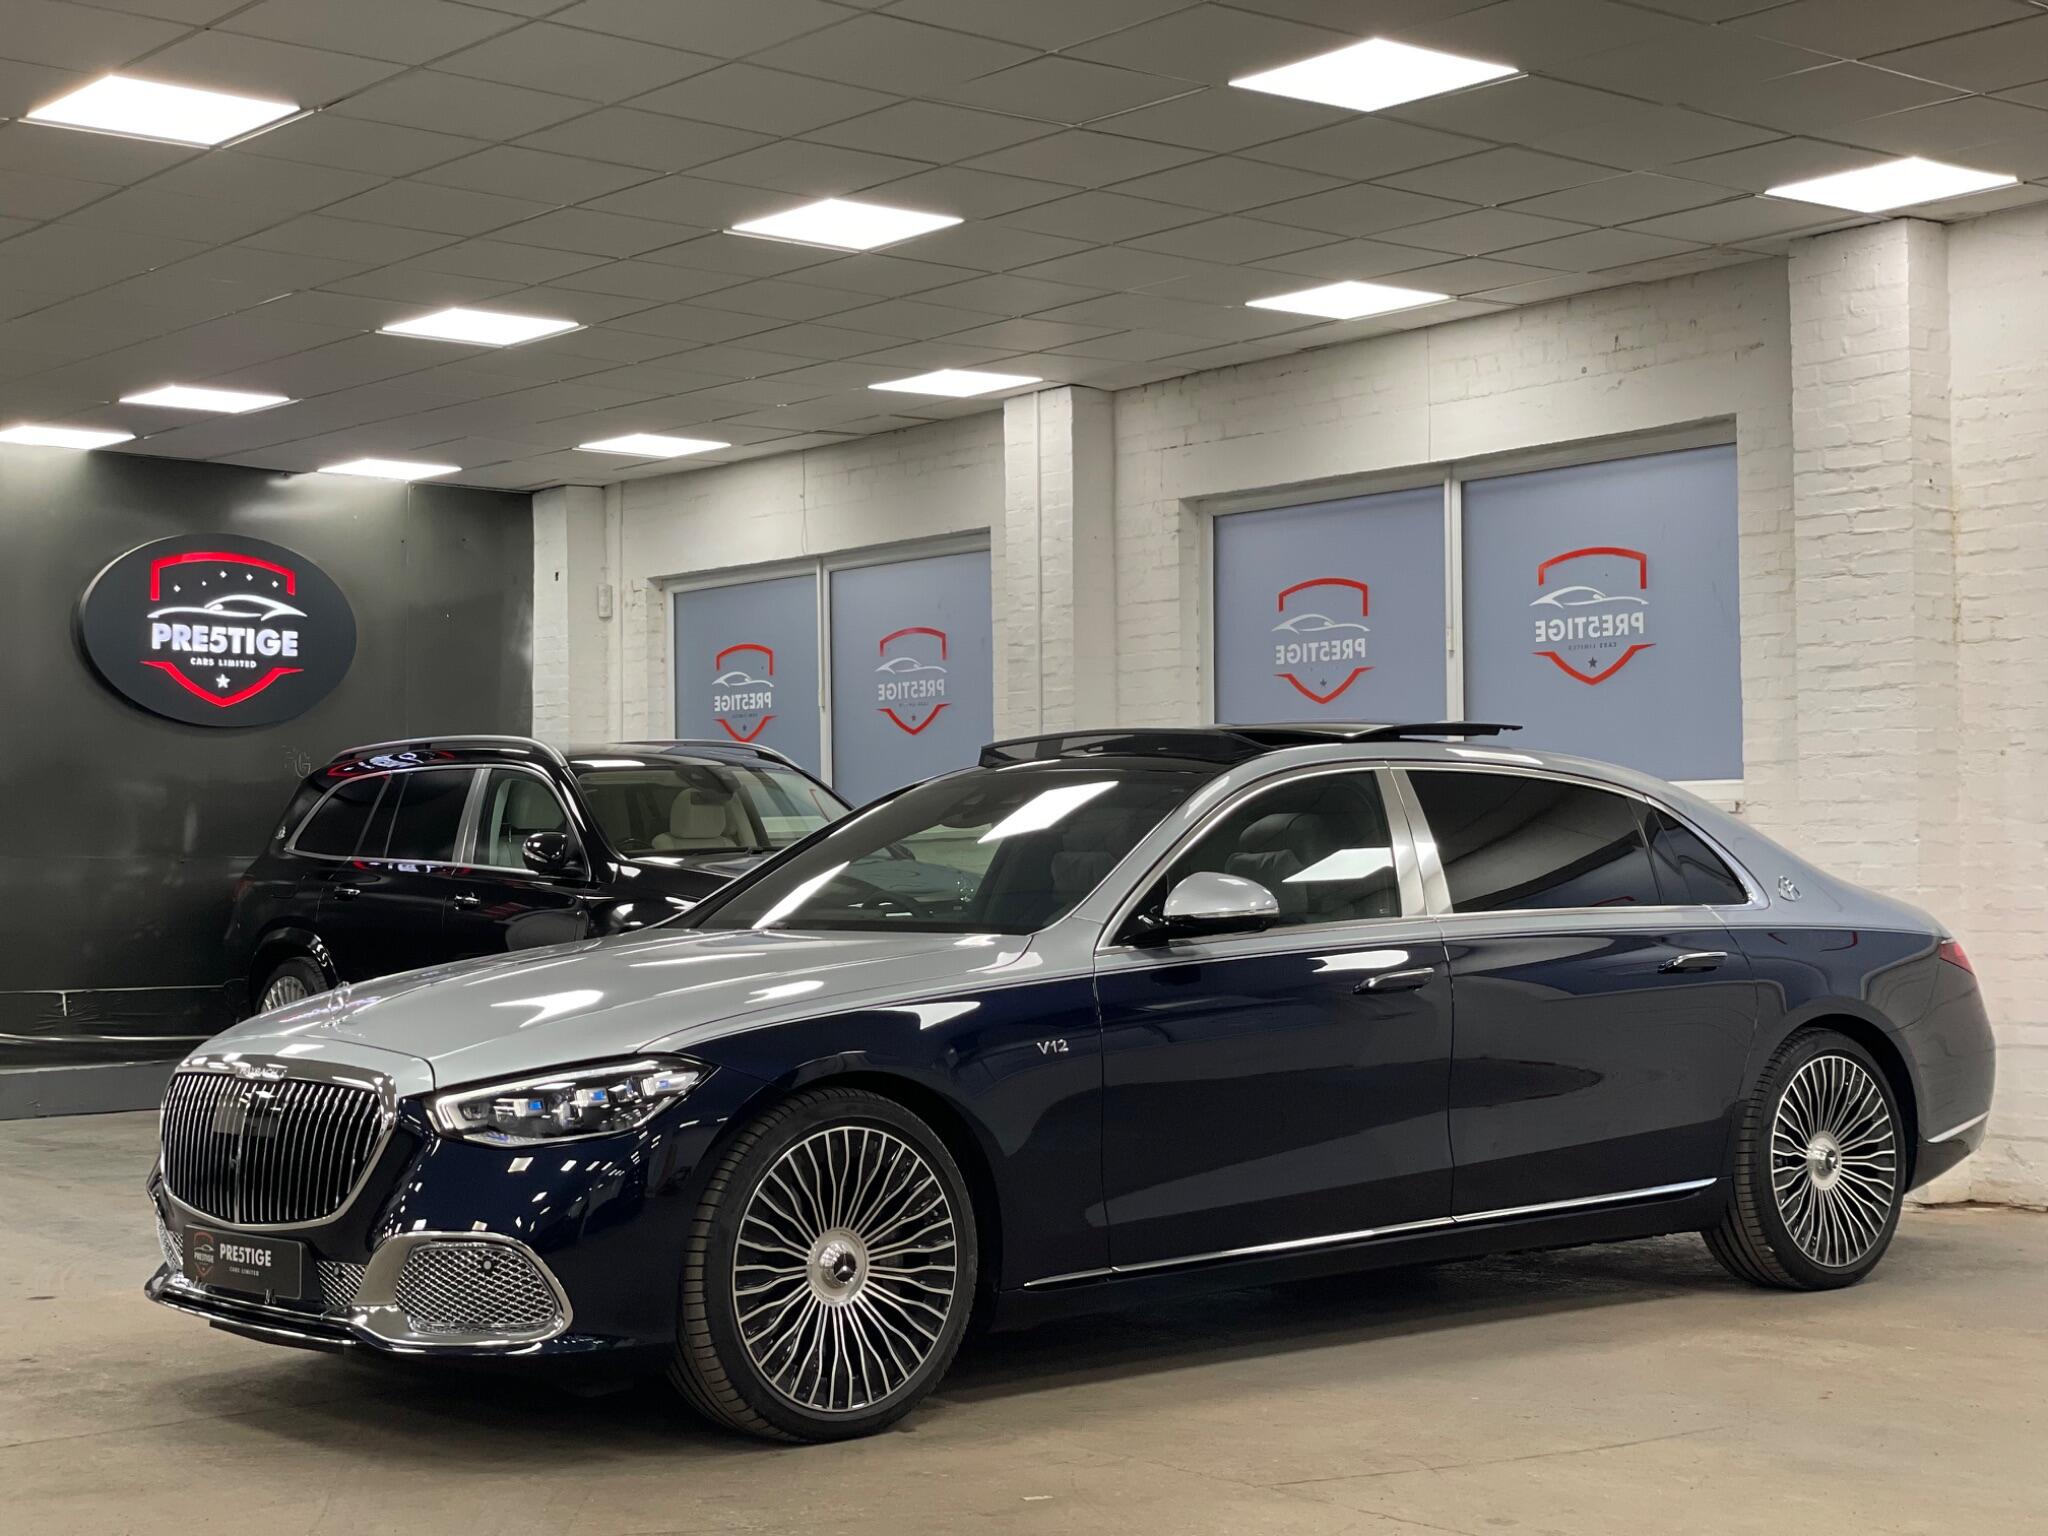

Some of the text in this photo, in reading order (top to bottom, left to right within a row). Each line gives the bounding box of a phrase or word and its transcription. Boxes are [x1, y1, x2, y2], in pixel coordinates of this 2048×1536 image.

[189, 656, 257, 669] CARS LIMITED
[1036, 1038, 1069, 1055] V12
